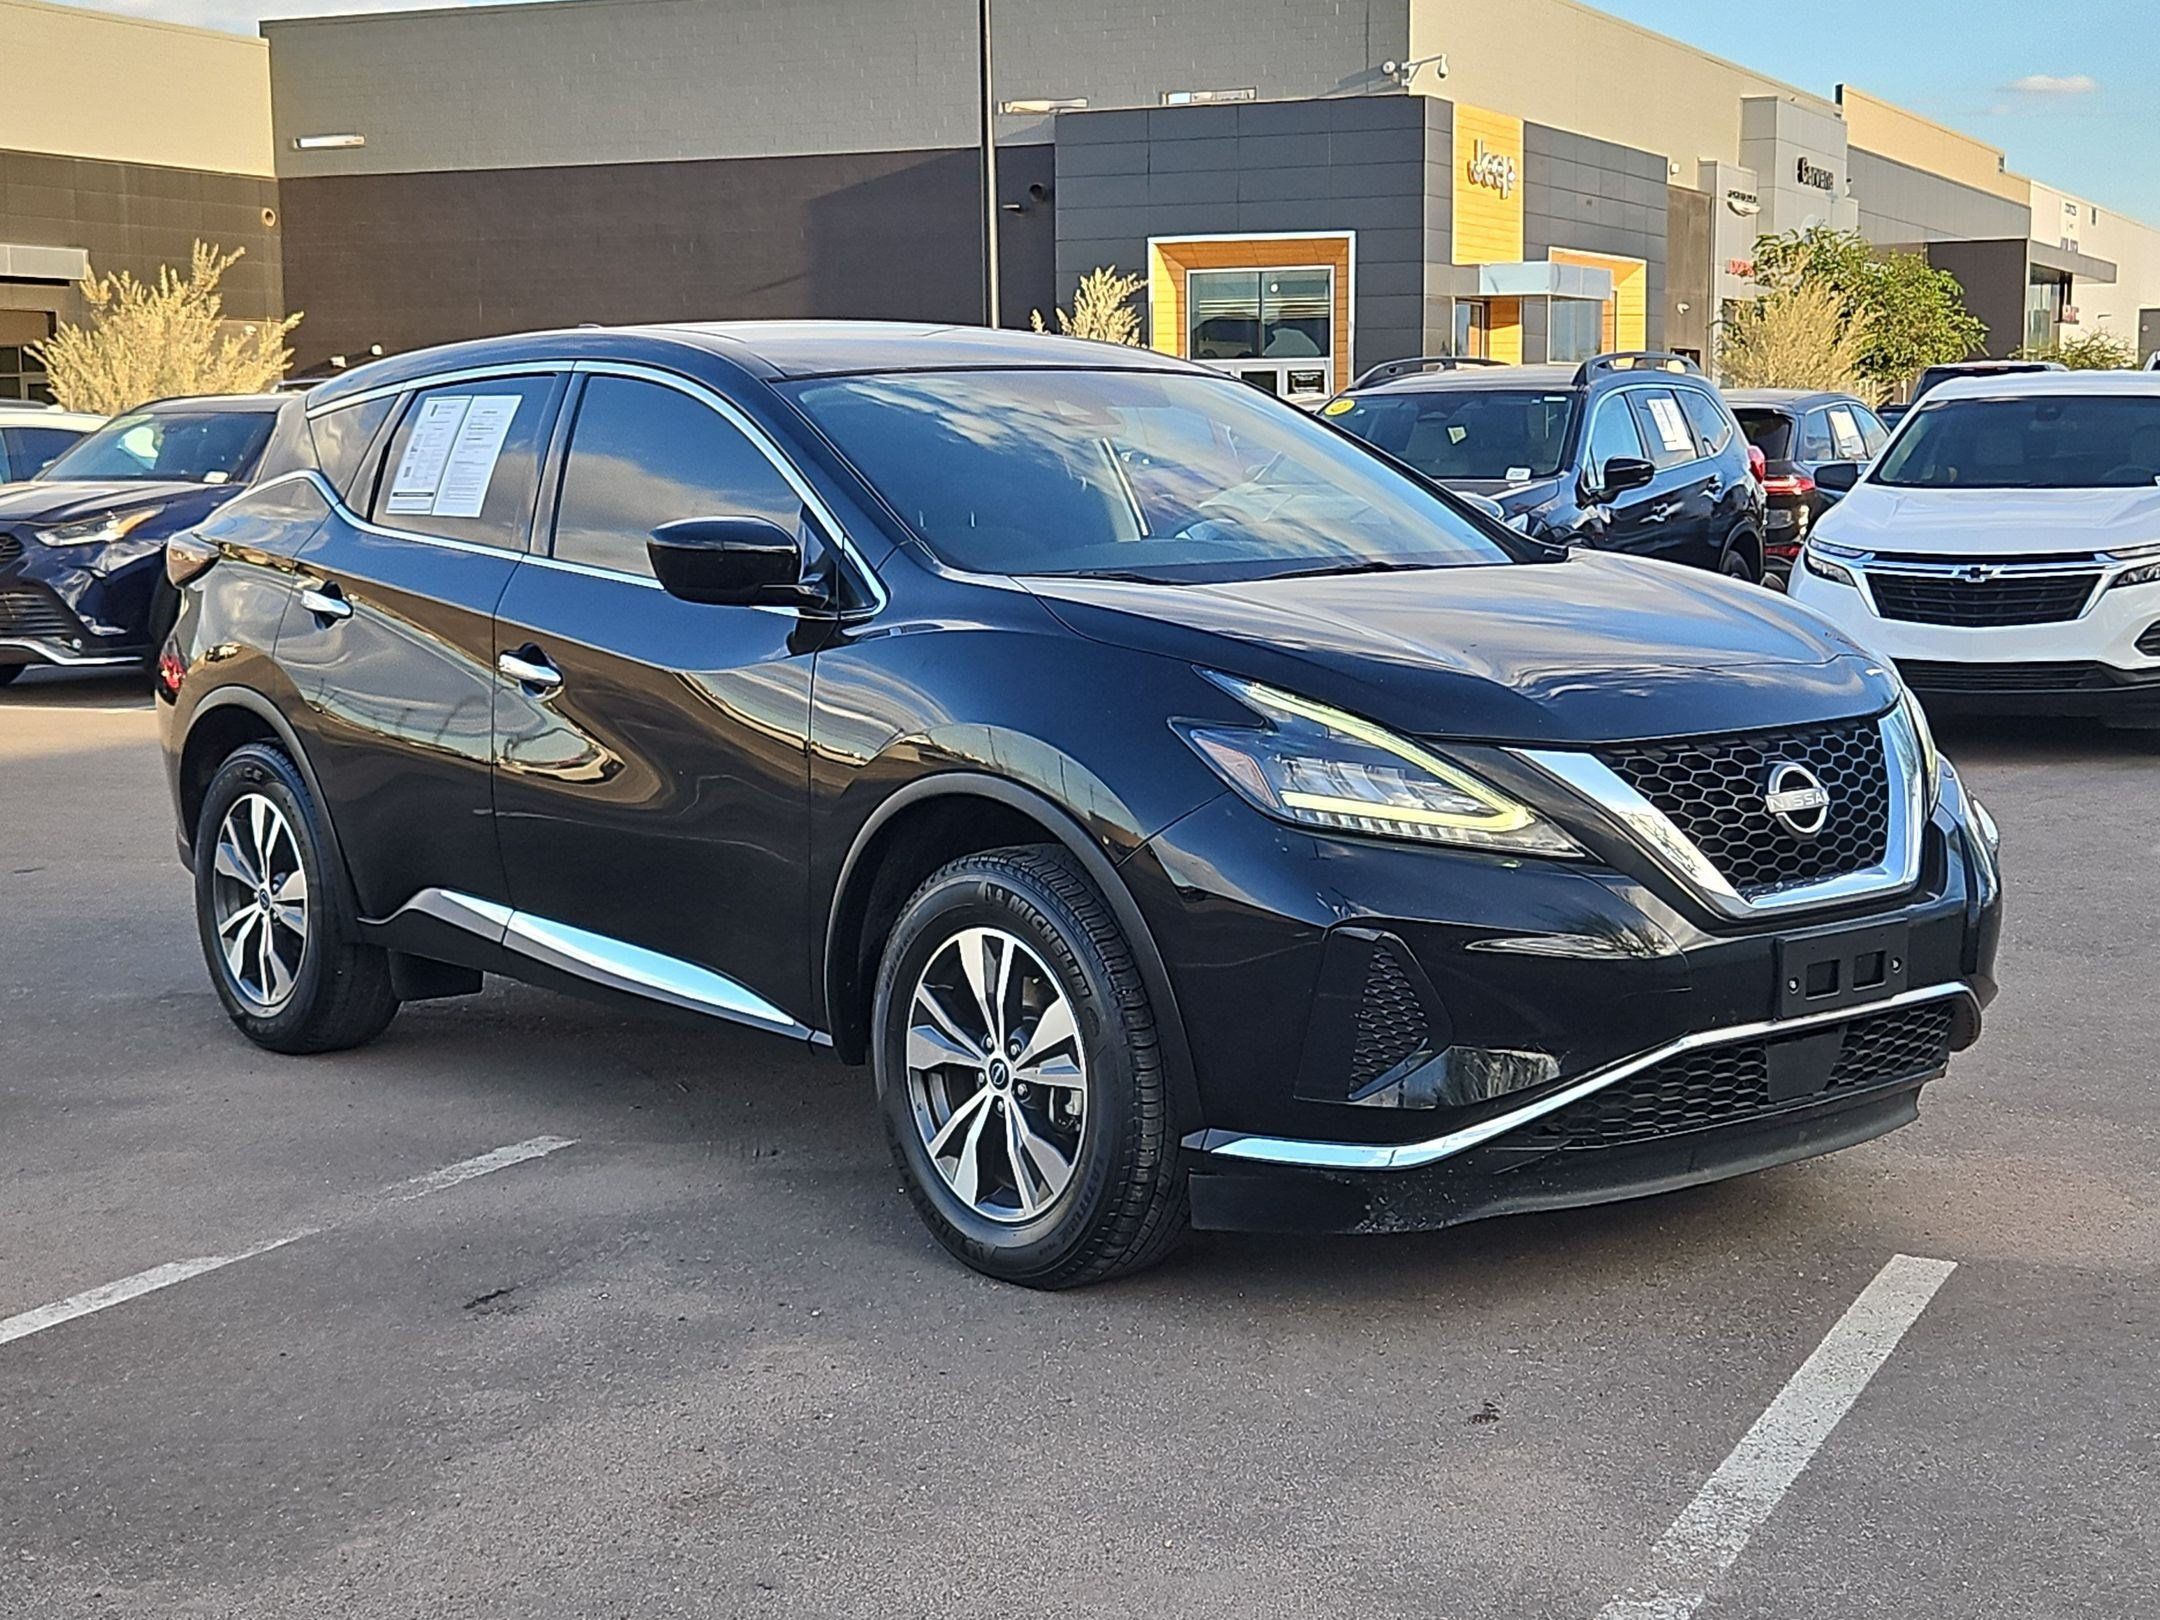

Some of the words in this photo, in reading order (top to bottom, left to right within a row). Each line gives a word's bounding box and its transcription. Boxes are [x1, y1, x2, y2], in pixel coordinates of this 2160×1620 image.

[1467, 139, 1515, 199] Jeep
[1769, 791, 1828, 809] NISSA
[1008, 895, 1090, 996] MICHELIN
